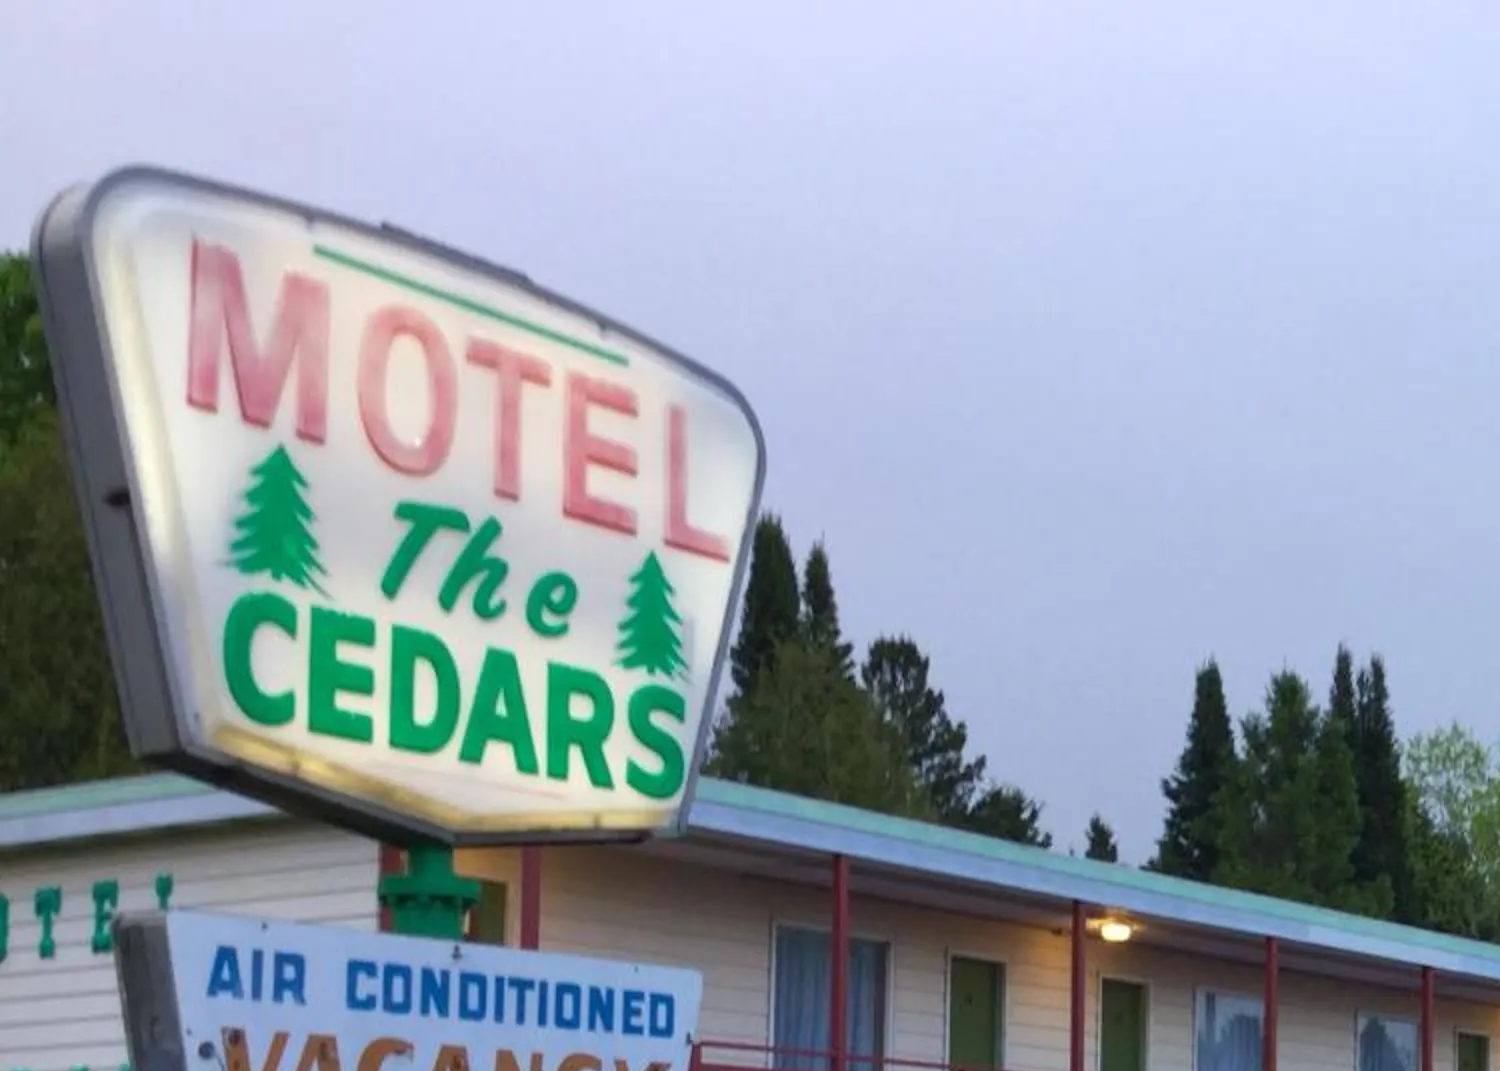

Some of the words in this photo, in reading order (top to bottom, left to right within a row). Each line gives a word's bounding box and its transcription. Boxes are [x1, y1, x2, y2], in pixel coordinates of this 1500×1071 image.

[186, 238, 730, 563] MOTEL
[381, 500, 578, 638] The
[223, 591, 686, 799] CEDARS
[207, 946, 306, 1005] AIR
[346, 959, 674, 1039] CONDITIONED
